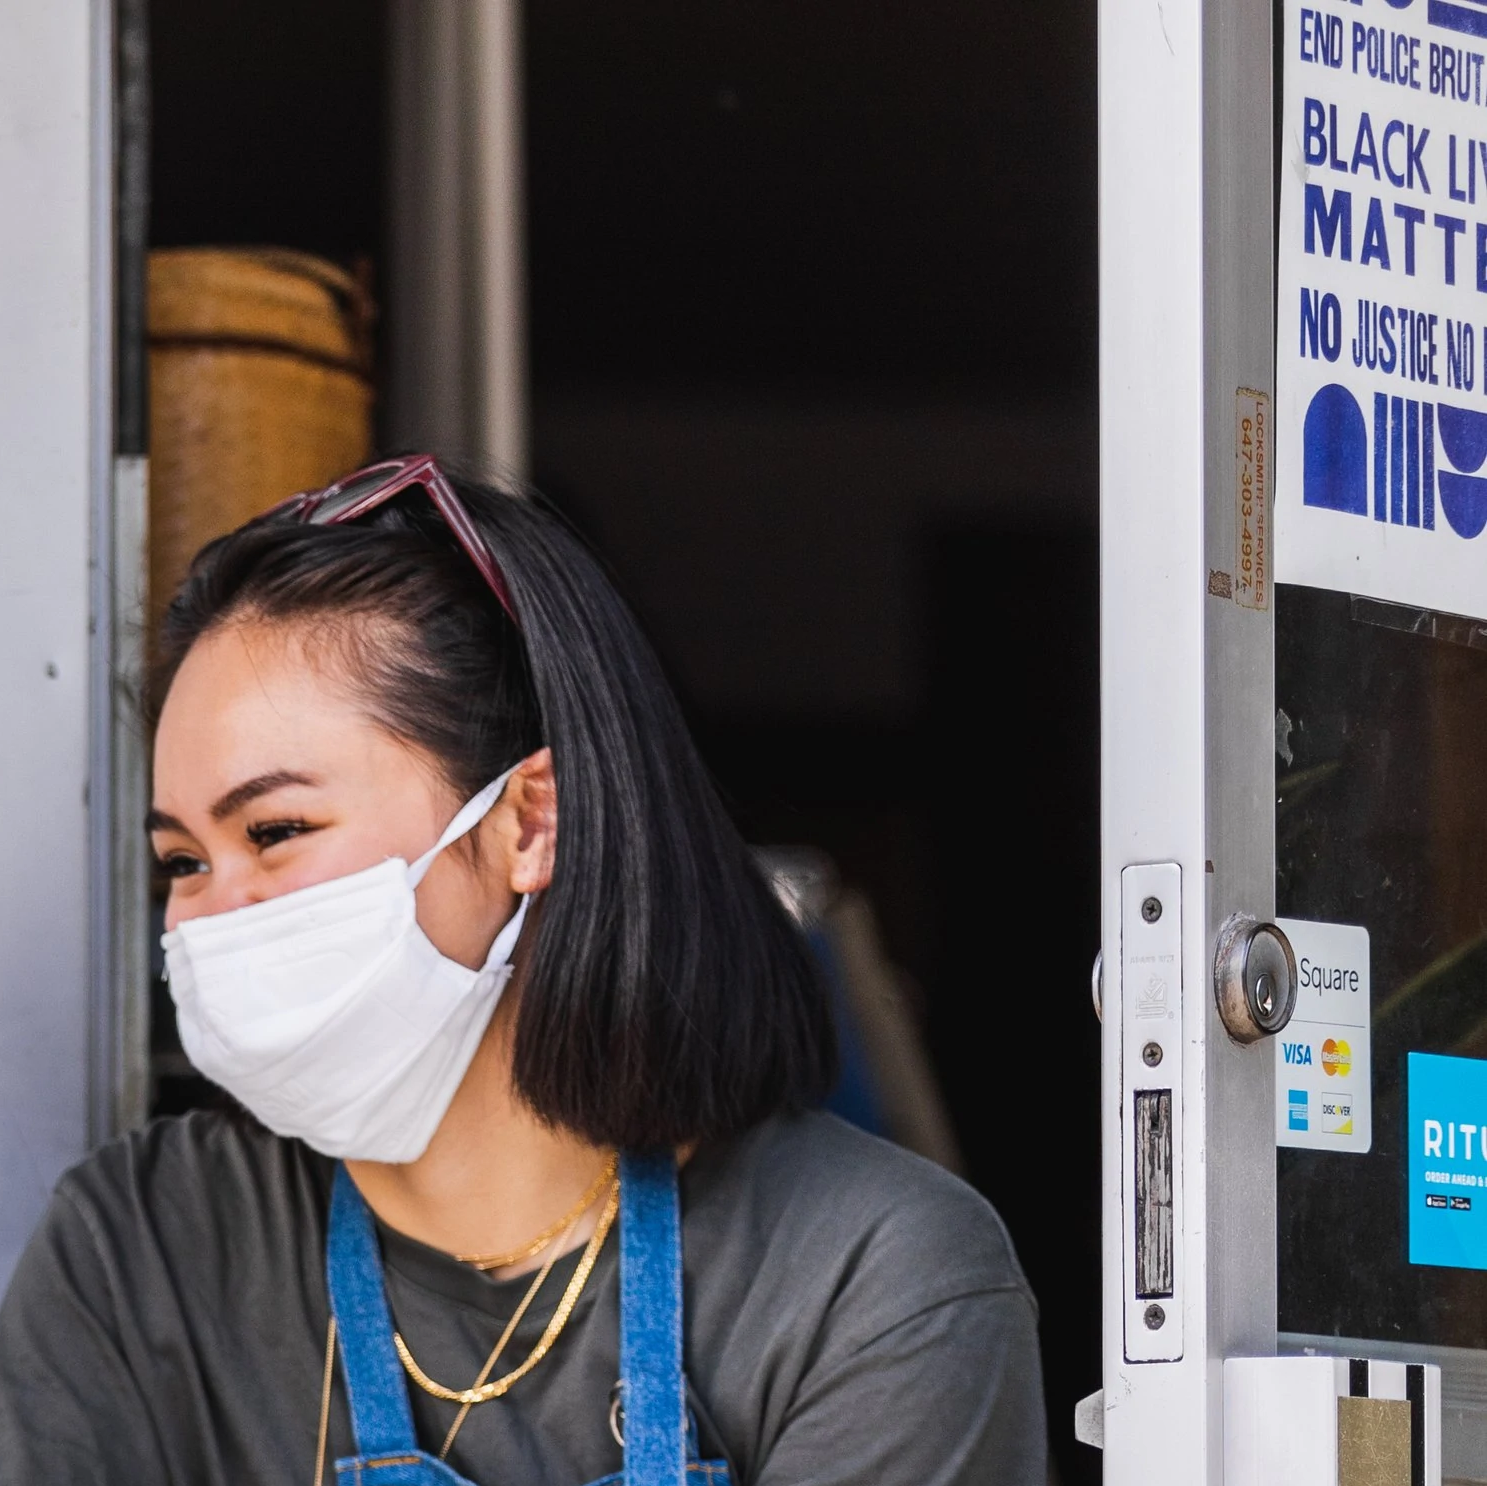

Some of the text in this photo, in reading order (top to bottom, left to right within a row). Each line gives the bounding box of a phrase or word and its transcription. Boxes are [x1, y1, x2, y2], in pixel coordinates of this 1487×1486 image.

[1300, 8, 1487, 107] END POLICE BRUT
[1303, 96, 1431, 195] BLACK
[1300, 286, 1342, 363] NO
[1352, 299, 1439, 386] JUSTICE
[1446, 318, 1475, 392] NO
[1241, 418, 1253, 588] 647-303-4997
[1256, 514, 1264, 602] SERVICES
[1300, 957, 1359, 996] Square
[1282, 1043, 1312, 1065] VISA
[1323, 1104, 1351, 1116] DISCOVER
[1425, 1171, 1450, 1184] ORDER
[1451, 1174, 1477, 1187] AHEAD
